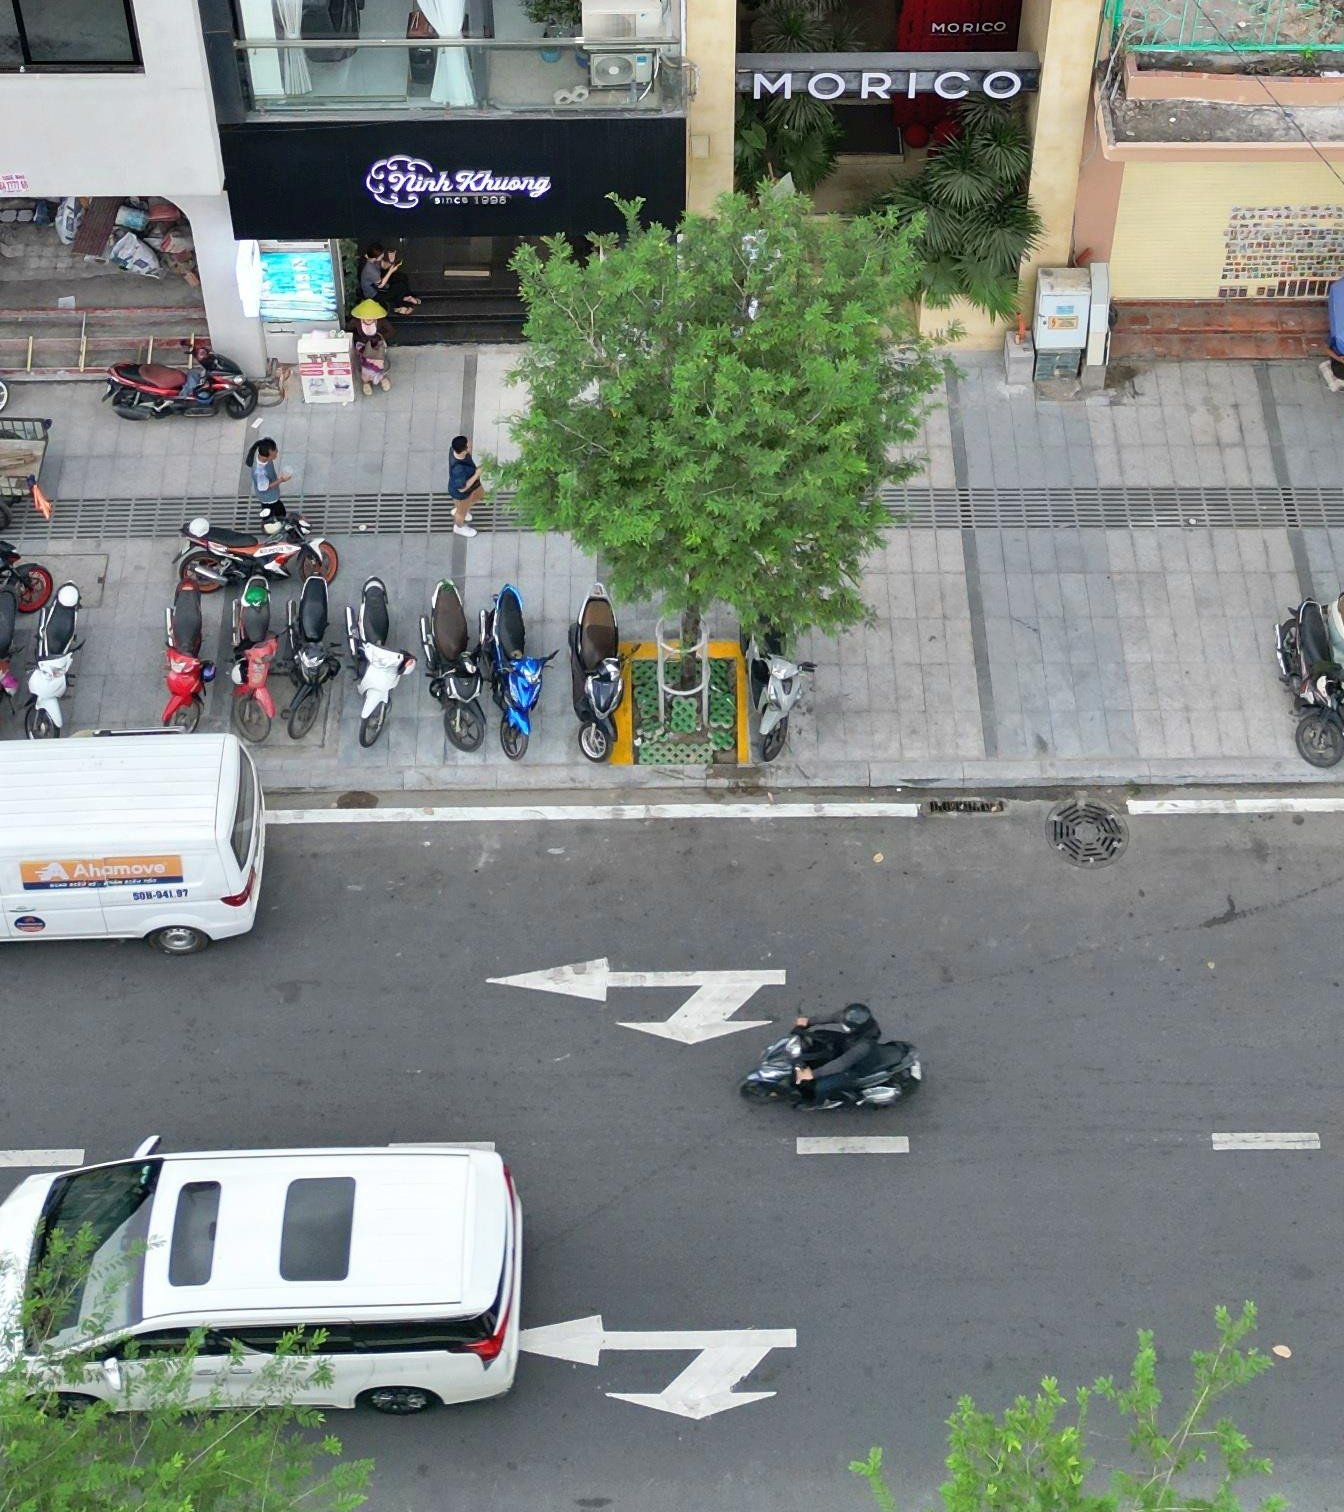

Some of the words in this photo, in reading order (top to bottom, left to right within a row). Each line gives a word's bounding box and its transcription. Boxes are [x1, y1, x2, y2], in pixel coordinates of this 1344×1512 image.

[931, 21, 1007, 33] MORICO
[753, 71, 1022, 100] MORICO
[388, 170, 452, 192] Ninh
[434, 196, 468, 205] since
[73, 862, 166, 878] Ahamove
